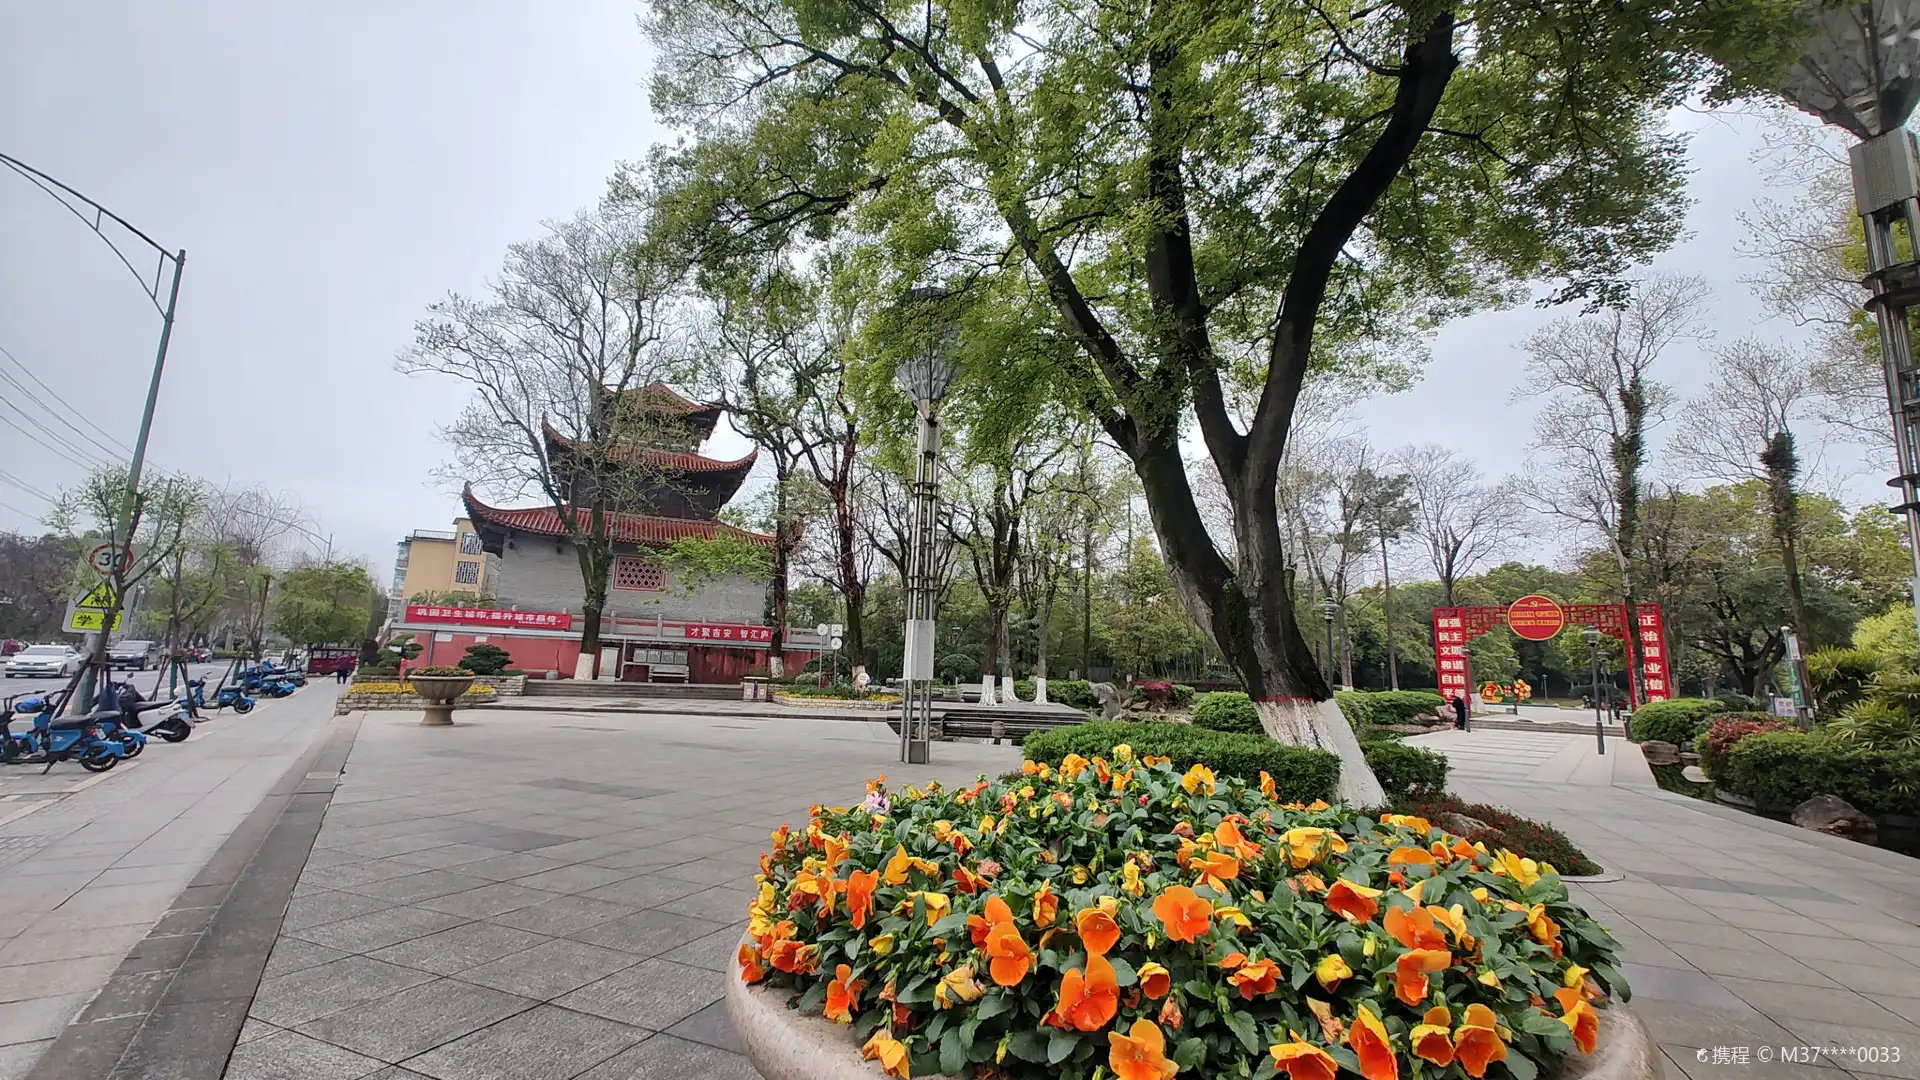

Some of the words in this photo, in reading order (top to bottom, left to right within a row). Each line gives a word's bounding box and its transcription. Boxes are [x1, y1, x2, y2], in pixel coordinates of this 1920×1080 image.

[1438, 618, 1461, 628] 富强
[1638, 615, 1656, 626] 正
[691, 627, 732, 639] 才聚吉安
[740, 629, 773, 640] 智汇庐
[1439, 632, 1462, 642] 民主
[1640, 630, 1658, 642] 治
[1440, 645, 1463, 656] 文明
[1642, 646, 1660, 657] 国
[1441, 660, 1464, 670] 和谐
[1643, 662, 1662, 673] 业
[1442, 674, 1465, 684] 自由
[1645, 679, 1663, 690] 信
